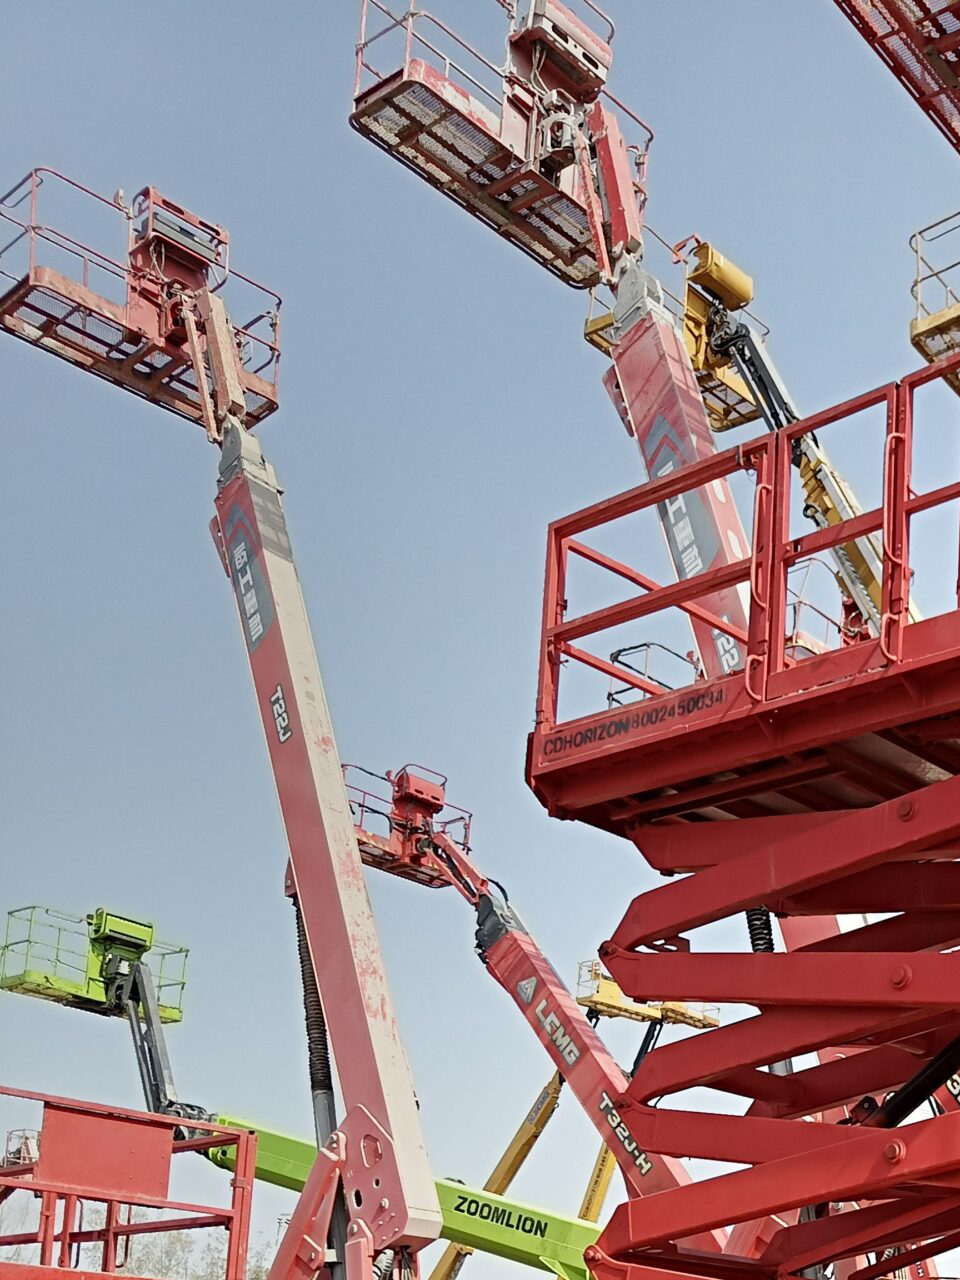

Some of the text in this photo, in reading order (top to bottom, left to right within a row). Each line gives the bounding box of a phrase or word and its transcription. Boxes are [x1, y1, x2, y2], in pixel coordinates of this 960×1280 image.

[271, 684, 293, 743] T22J
[543, 719, 630, 757] CDHORIZON
[599, 1091, 652, 1176] T32J-H
[454, 1195, 548, 1238] ZOOMLION
